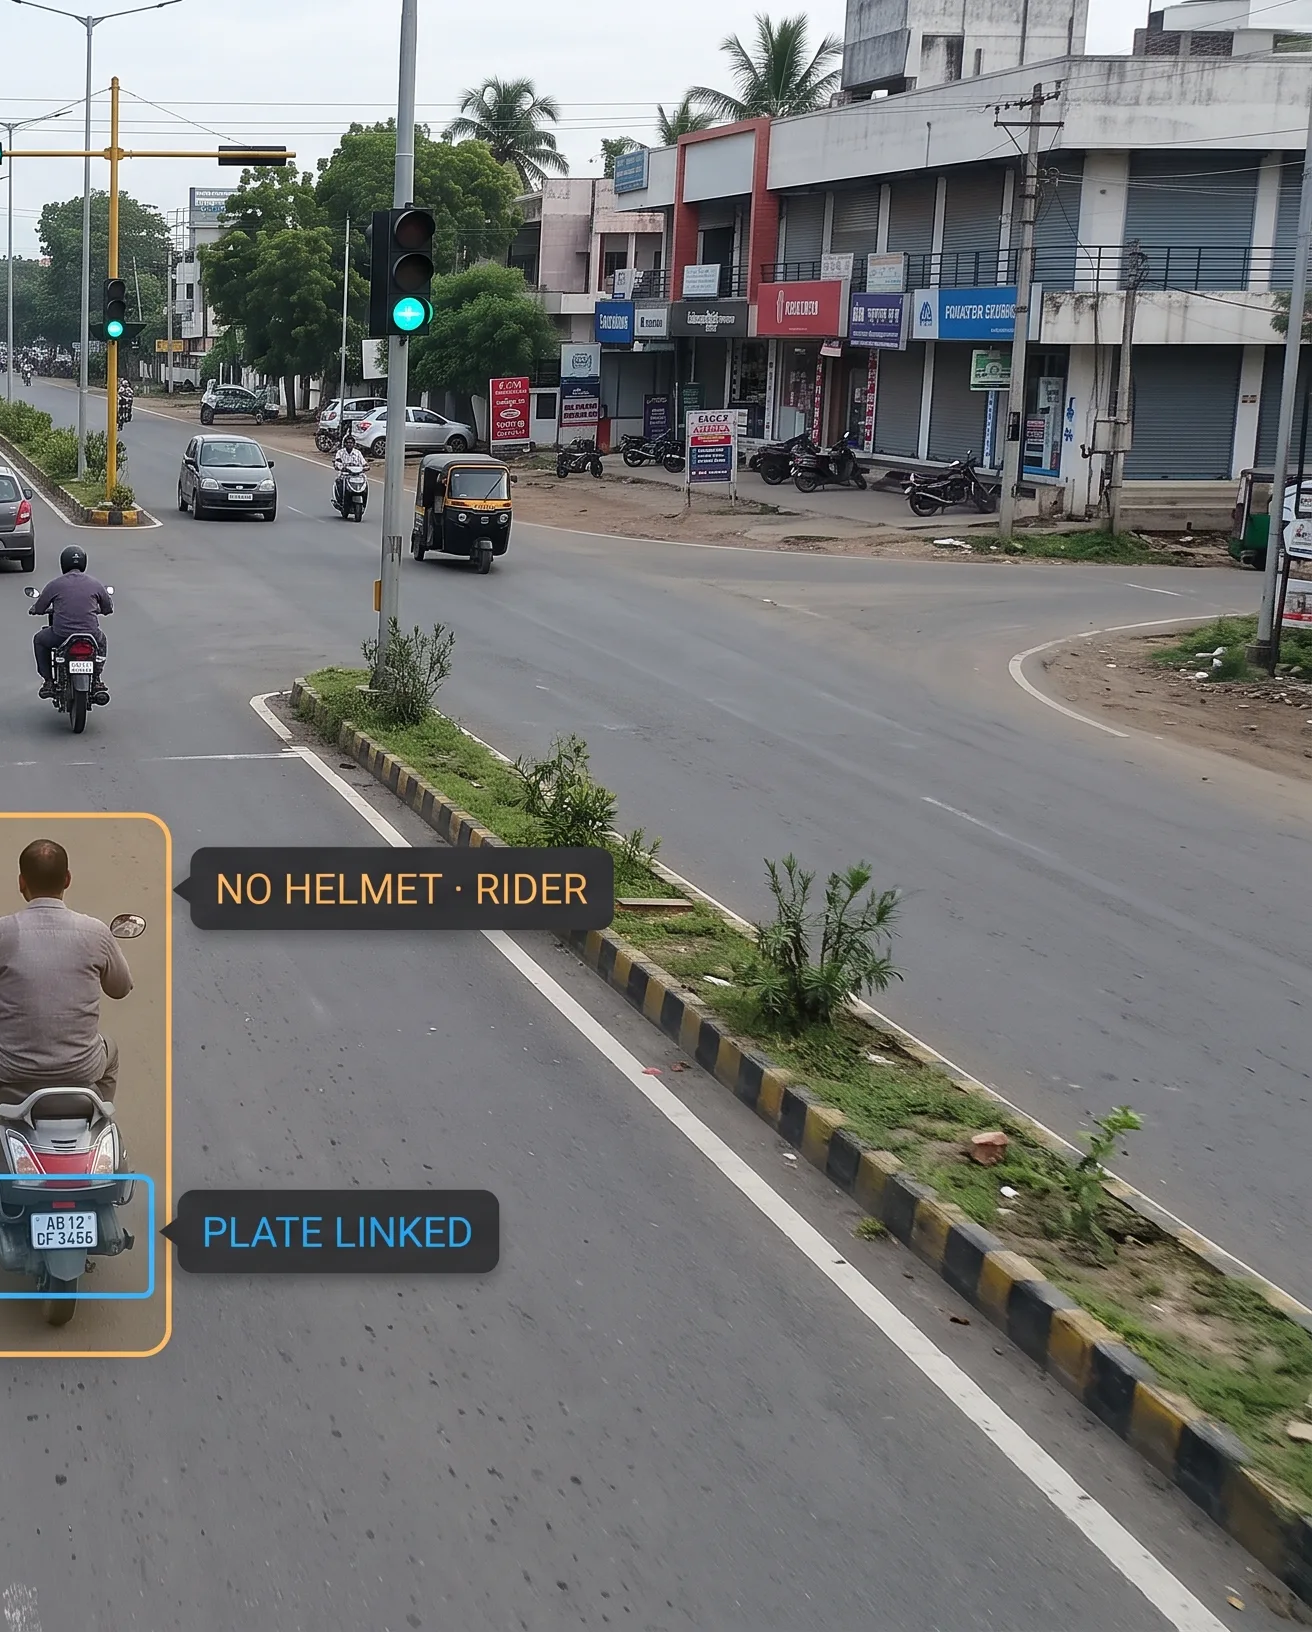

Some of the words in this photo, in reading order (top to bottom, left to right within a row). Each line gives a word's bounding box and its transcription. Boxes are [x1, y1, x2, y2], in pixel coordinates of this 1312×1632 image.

[46, 1216, 65, 1230] AB
[68, 1215, 85, 1230] 12
[58, 1231, 93, 1245] 3456
